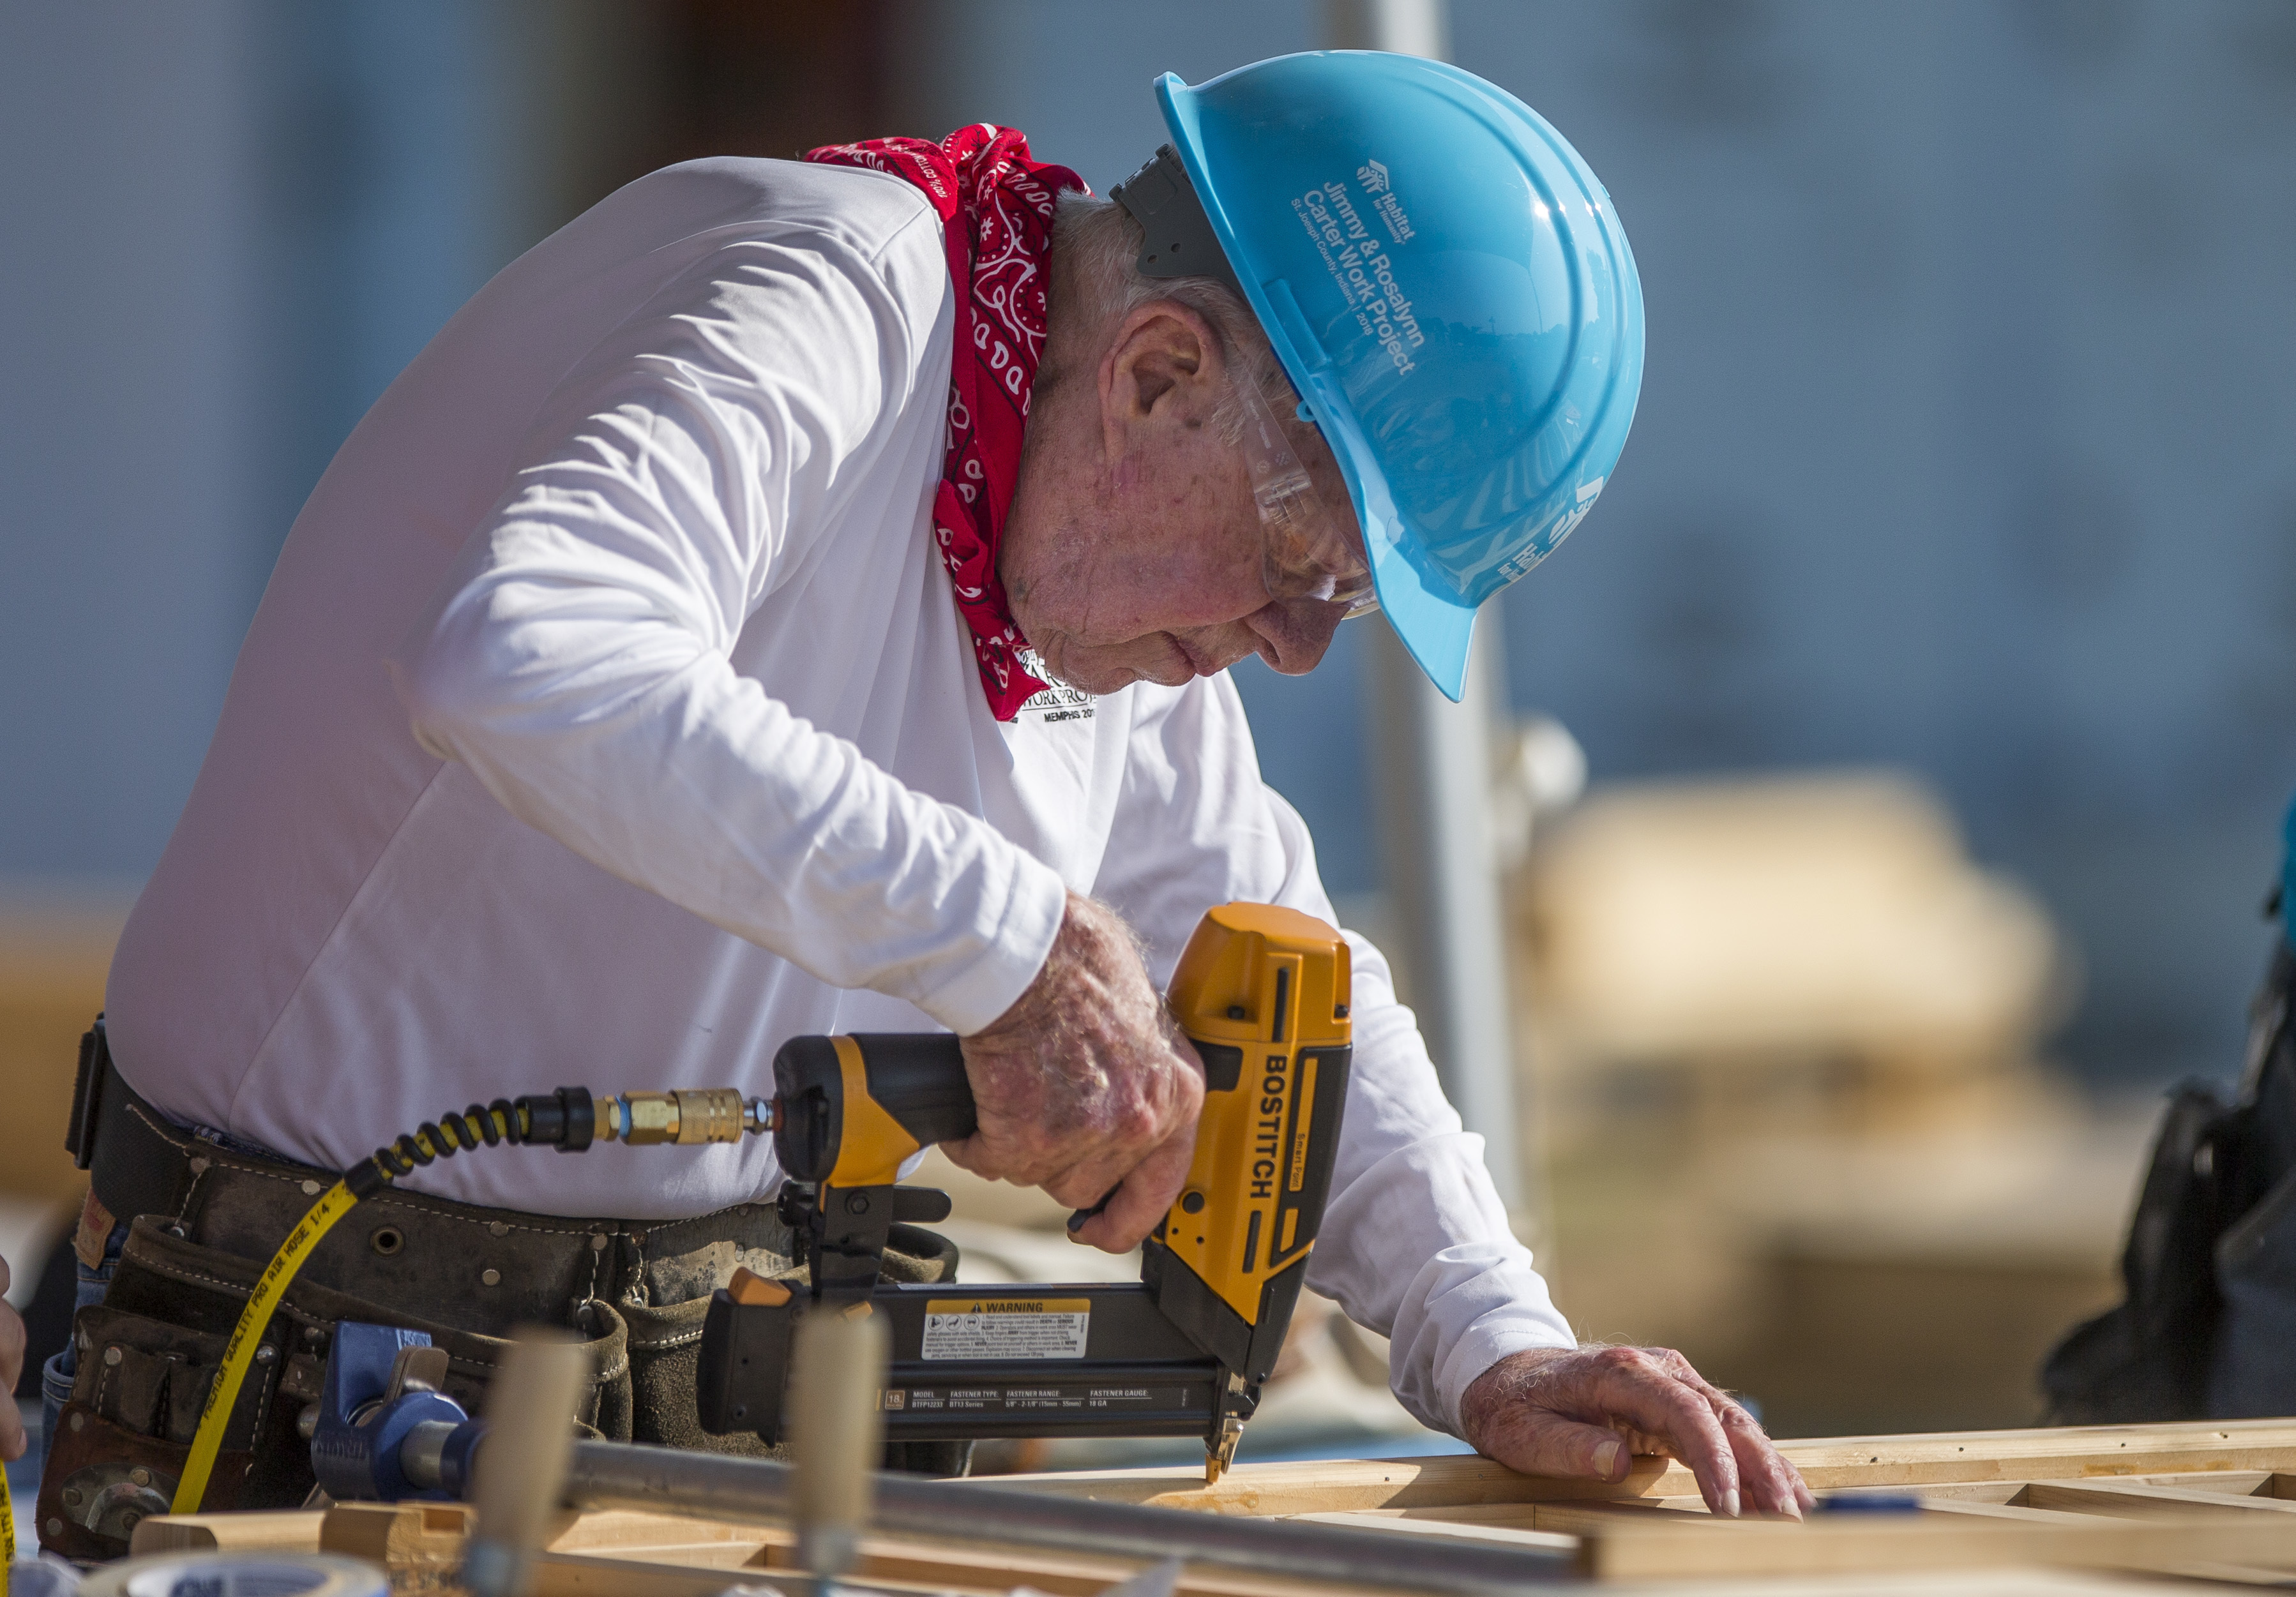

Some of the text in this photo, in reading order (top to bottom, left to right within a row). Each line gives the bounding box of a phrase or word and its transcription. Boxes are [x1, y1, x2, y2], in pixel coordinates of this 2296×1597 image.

[929, 179, 948, 199] 100%
[1373, 199, 1402, 243] for Humanity
[1380, 192, 1416, 240] Habitat
[1291, 199, 1302, 211] St.
[1317, 241, 1337, 274] County,
[1335, 273, 1356, 305] Indiana
[1356, 312, 1374, 336] 2018
[1304, 190, 1416, 376] Carter Work Project
[1324, 182, 1425, 348] Jimmy & Rosalynn
[1044, 710, 1081, 723] MEMPHIS
[1250, 1054, 1291, 1199] BOSTITCH
[203, 1202, 330, 1420] PREMIUM QUALITY PRO AIR HOSE 1/4
[986, 1302, 1043, 1312] WARNING
[888, 1394, 900, 1404] 18
